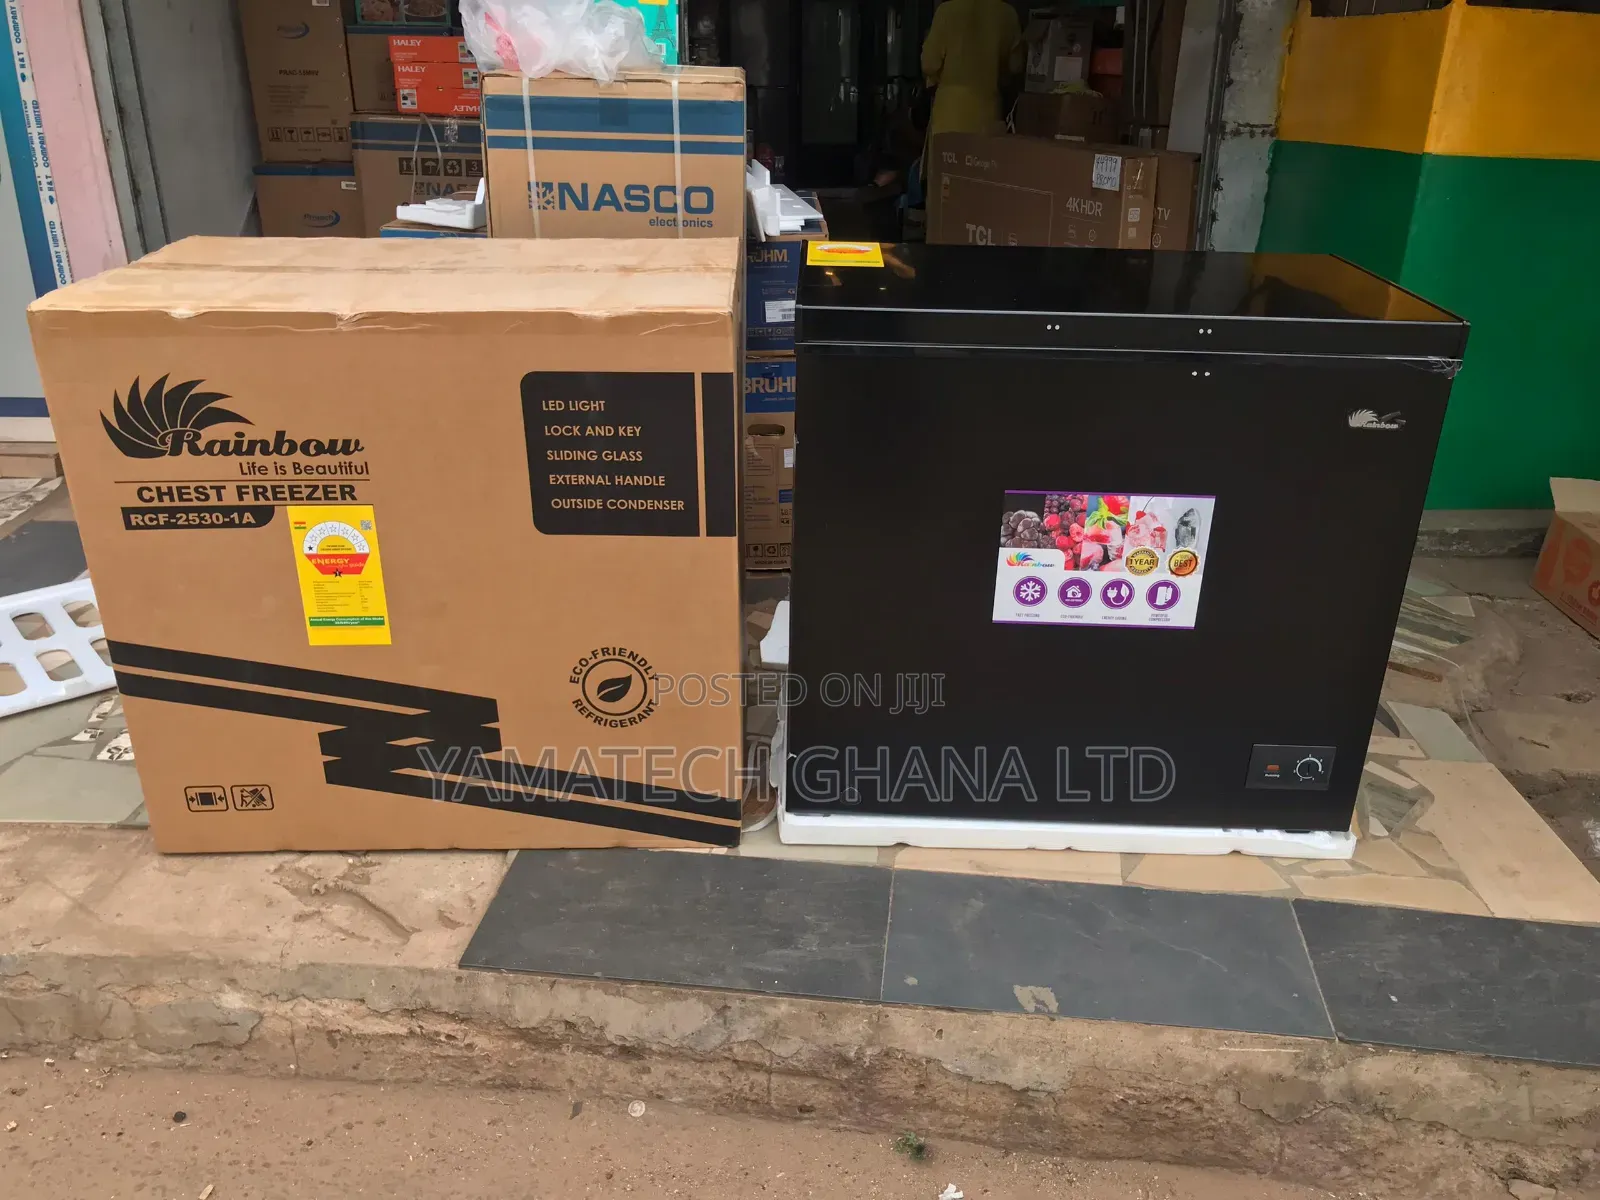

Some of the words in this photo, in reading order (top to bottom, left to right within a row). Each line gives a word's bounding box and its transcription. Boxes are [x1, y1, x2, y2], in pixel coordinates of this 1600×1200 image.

[10, 6, 22, 44] COMPANY
[393, 39, 422, 47] HALEY
[397, 65, 426, 73] HALEY
[31, 99, 43, 129] LIMITED
[37, 131, 50, 168] COMPANY
[942, 151, 957, 164] TCL
[1095, 173, 1117, 188] PROMO
[558, 182, 715, 215] NASCO
[1065, 197, 1080, 213] 4K
[1080, 199, 1103, 217] HDR
[649, 216, 713, 228] electonics
[49, 220, 60, 248] LIMITED
[966, 223, 997, 246] TCL
[55, 250, 67, 285] COMPANY
[542, 400, 565, 411] LED
[569, 400, 606, 412] LIGHT
[544, 425, 581, 437] LOCK
[585, 426, 615, 437] AND
[618, 426, 642, 437] KEY
[157, 427, 365, 457] Rainbow
[547, 450, 598, 462] SLIDING
[602, 450, 643, 462] GLASS
[239, 461, 269, 476] Life
[274, 461, 287, 476] is
[293, 461, 369, 476] Beautiful
[549, 474, 612, 486] EXTERNAL
[615, 475, 666, 486] HANDLE
[137, 485, 227, 503] CHEST
[236, 484, 358, 502] FREEZER
[551, 498, 603, 510] OUTSIDE
[607, 499, 685, 511] CONDENSER
[129, 512, 256, 527] RCF-2530-1A
[311, 558, 350, 566] ENERGY
[1174, 559, 1193, 568] BEST
[569, 646, 660, 685] ECO-FRIENDLY
[571, 698, 658, 729] REFRIGERANT
